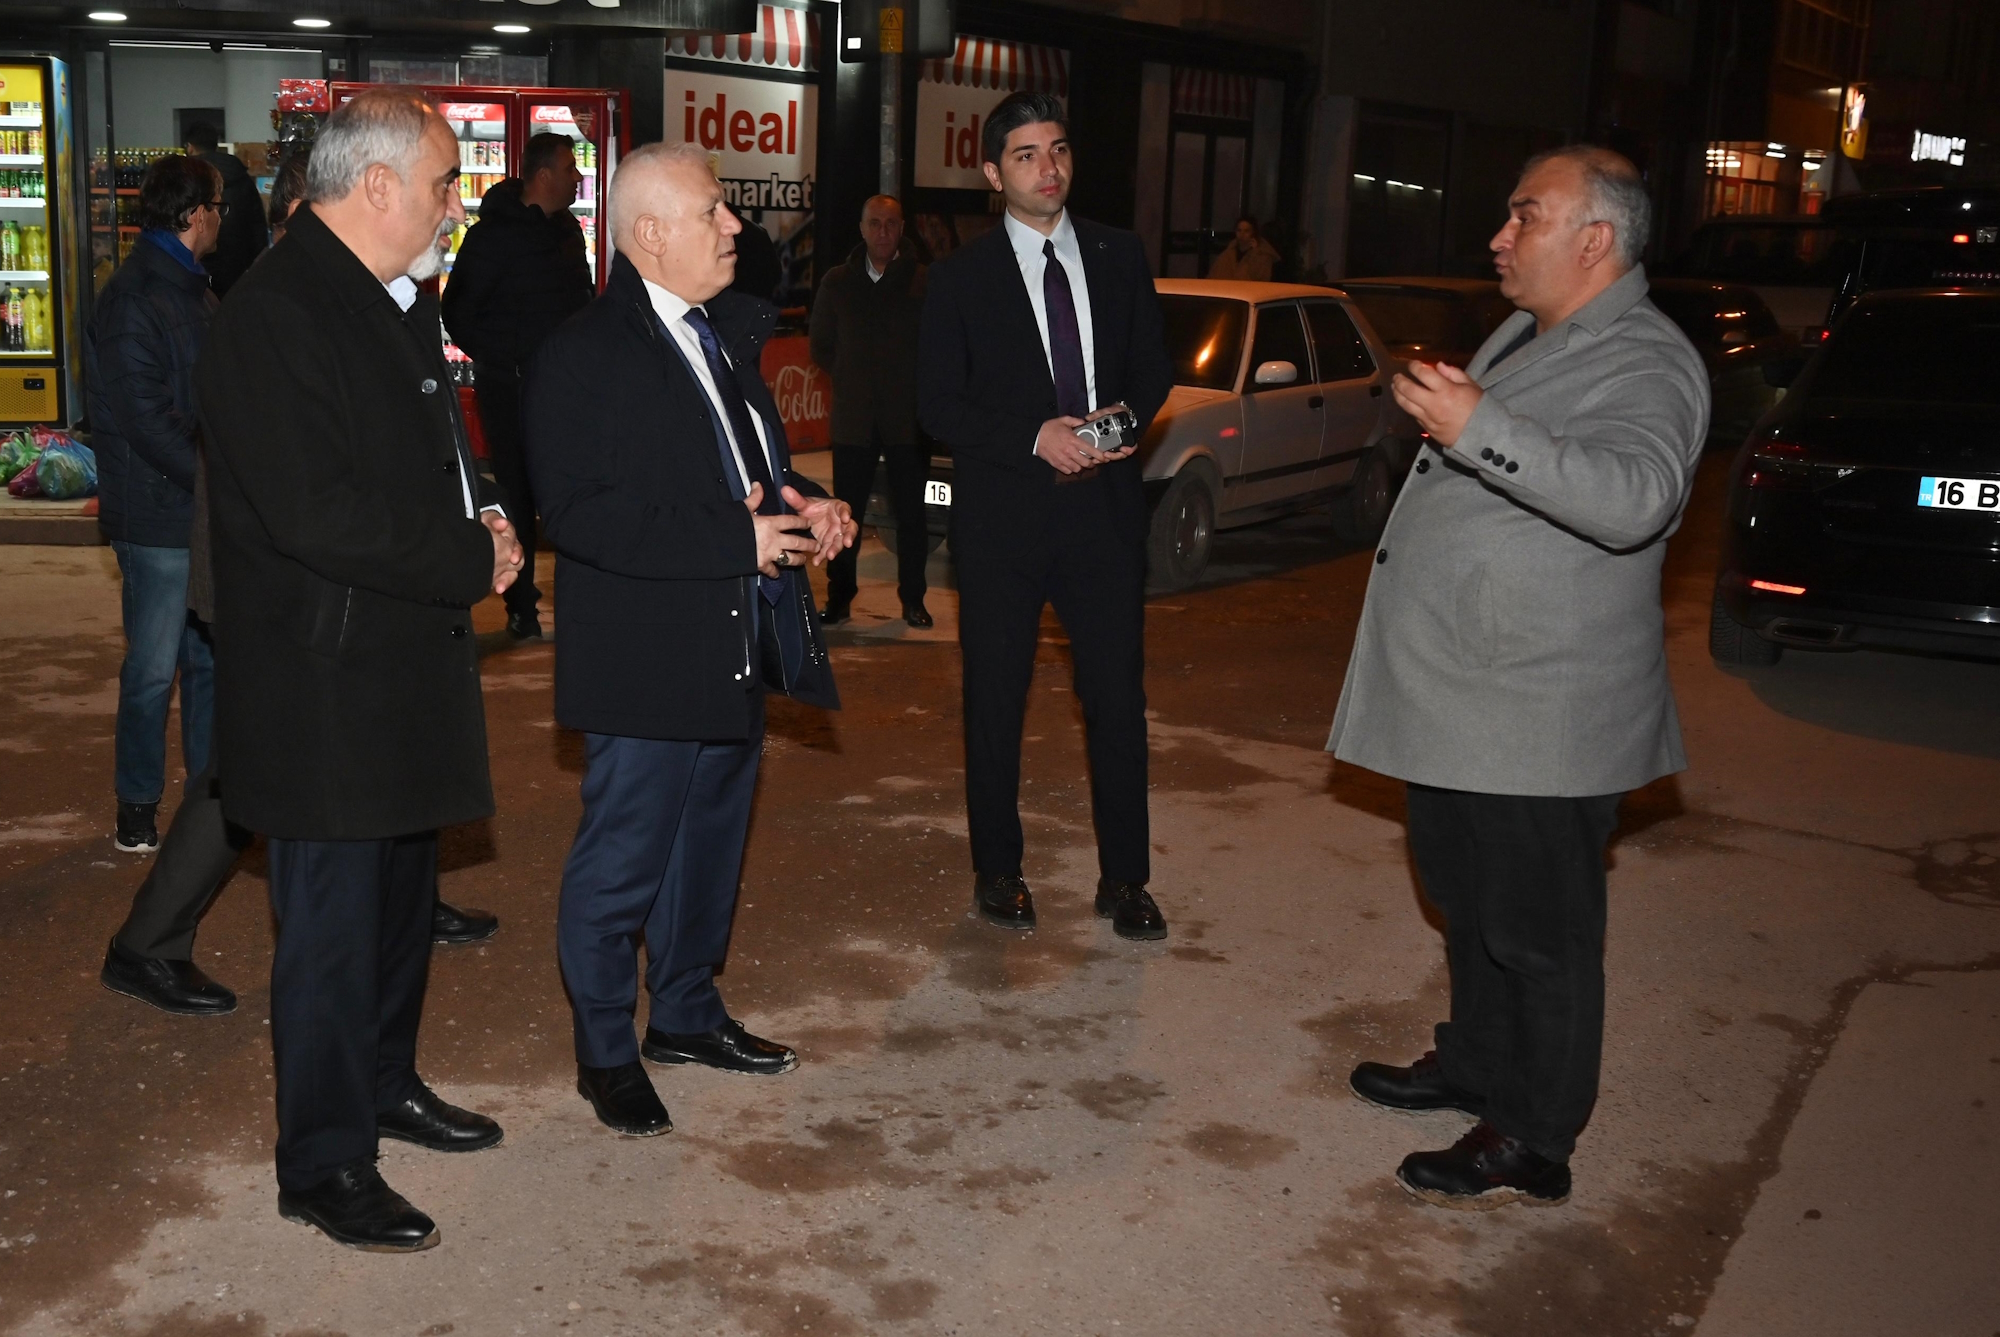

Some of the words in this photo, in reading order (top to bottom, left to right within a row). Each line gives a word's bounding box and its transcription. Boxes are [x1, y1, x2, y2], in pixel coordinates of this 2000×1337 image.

[446, 105, 487, 119] Coca-Cola
[684, 90, 798, 155] ideal
[721, 173, 812, 209] market
[931, 484, 946, 502] 16
[1920, 493, 1932, 502] TR
[1937, 480, 1965, 506] 16
[1977, 483, 2000, 508] B
